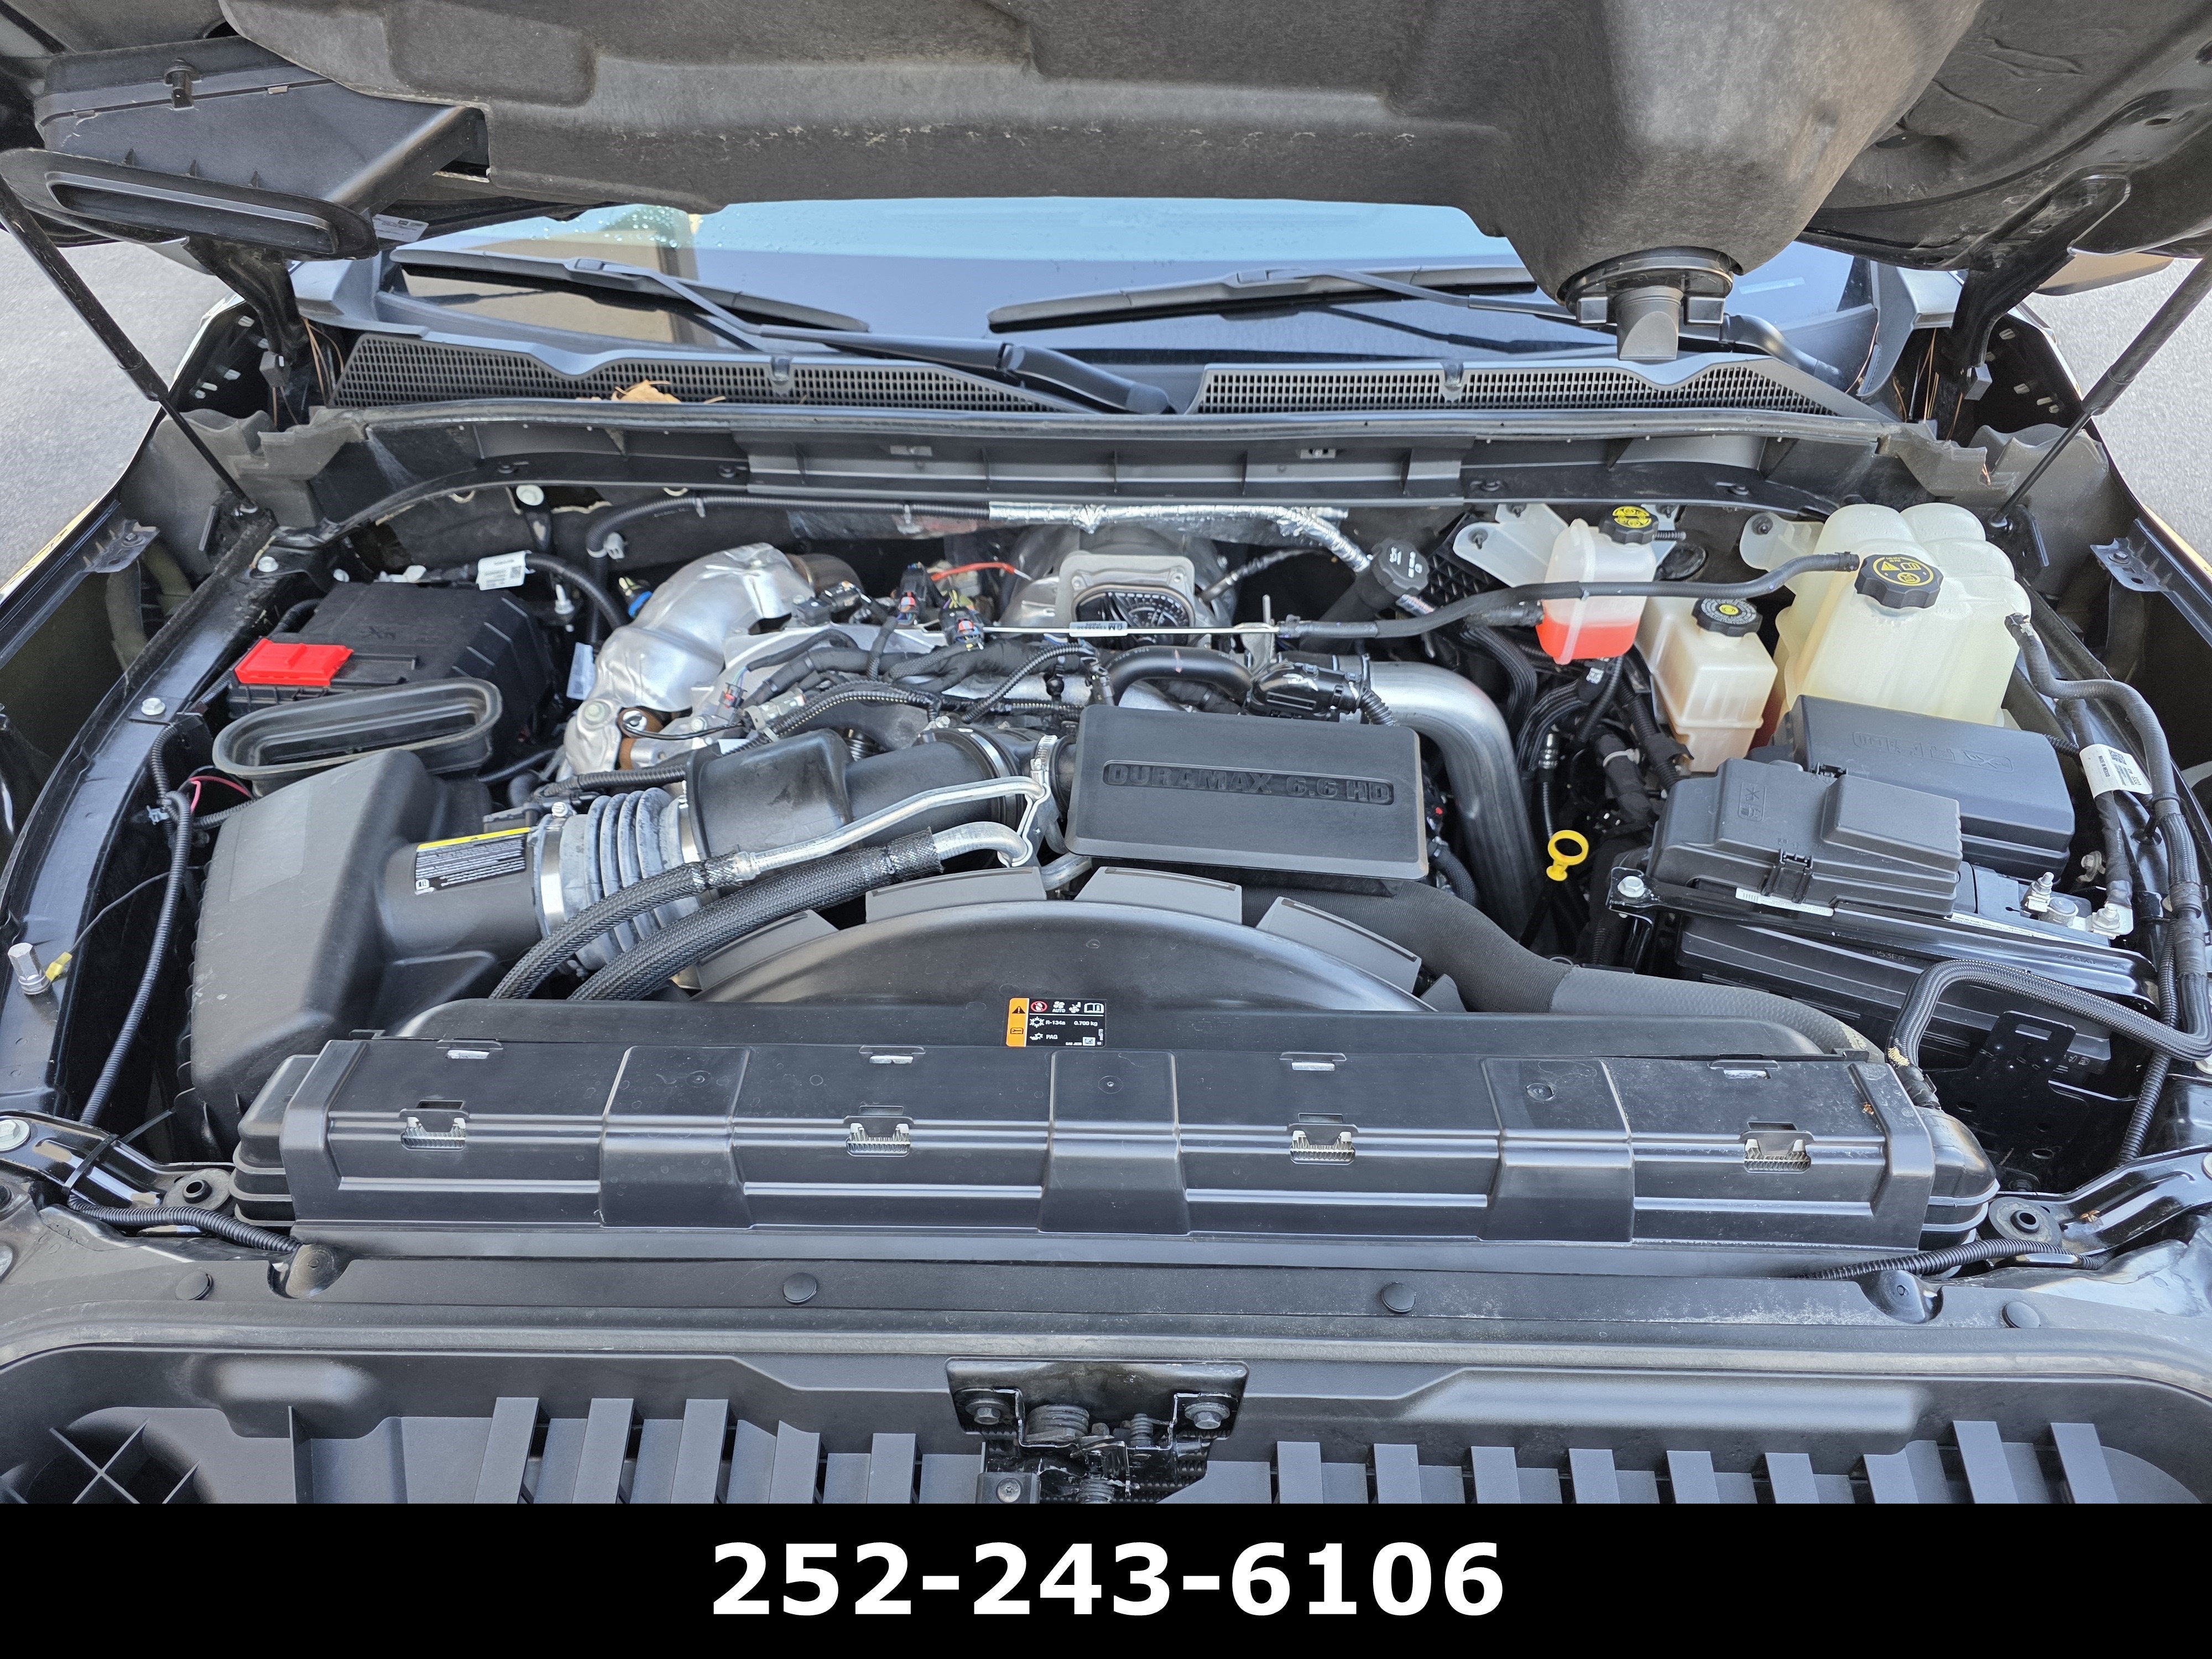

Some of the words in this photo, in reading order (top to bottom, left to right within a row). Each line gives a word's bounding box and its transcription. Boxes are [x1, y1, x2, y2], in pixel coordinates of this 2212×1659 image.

[1107, 764, 1272, 794] DURAMAX
[1286, 776, 1338, 799] 6.6
[1345, 780, 1390, 803] HD
